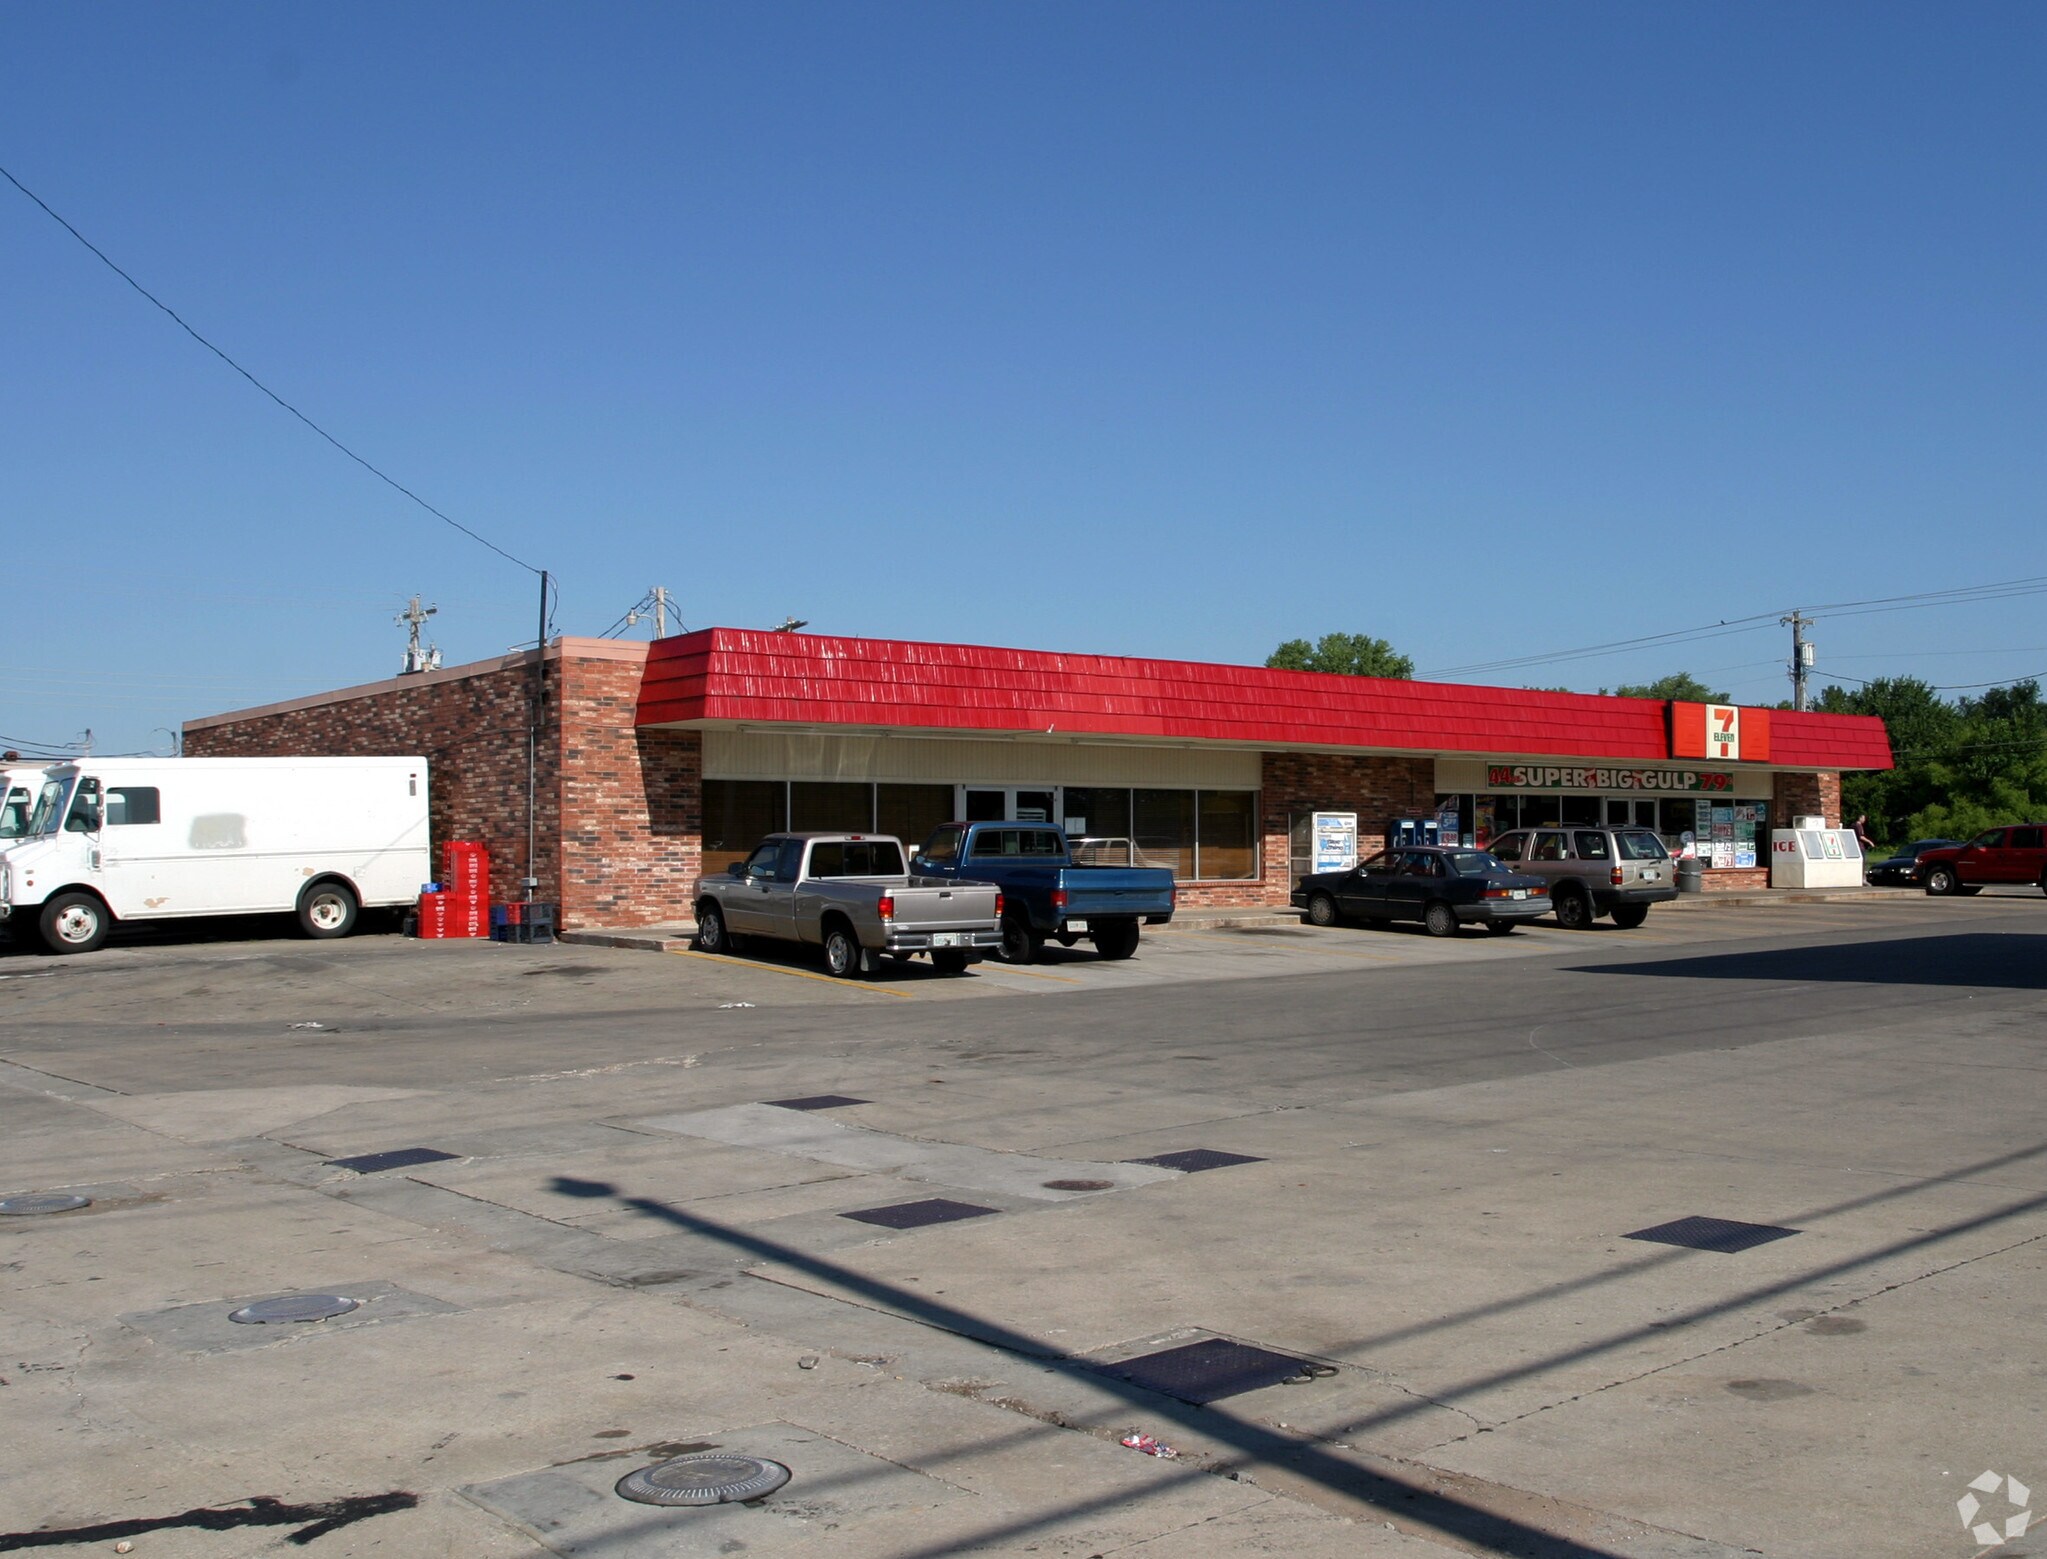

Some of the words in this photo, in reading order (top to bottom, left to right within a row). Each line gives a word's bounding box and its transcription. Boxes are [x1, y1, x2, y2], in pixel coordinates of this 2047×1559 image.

[1513, 766, 1587, 787] SUPER
[1596, 769, 1633, 787] BIG
[1640, 771, 1697, 789] GULP
[1773, 841, 1796, 852] ICE
